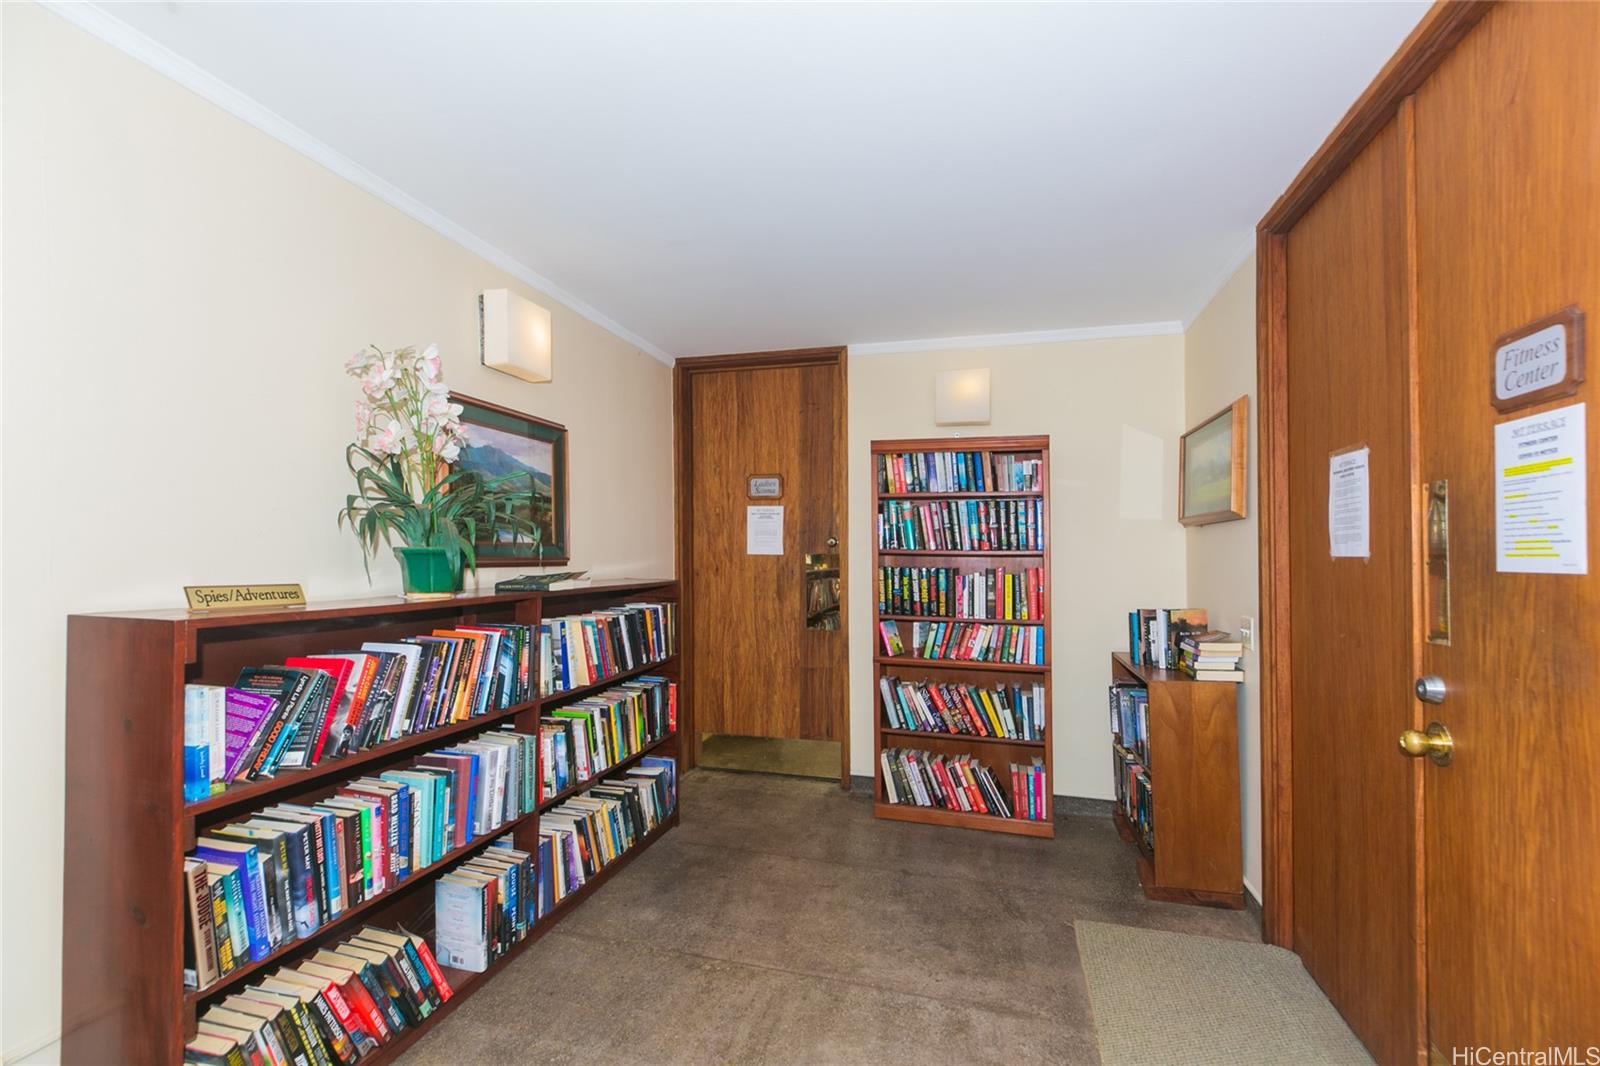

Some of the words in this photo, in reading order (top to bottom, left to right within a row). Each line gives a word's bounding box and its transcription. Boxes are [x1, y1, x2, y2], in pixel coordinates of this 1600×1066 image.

[1503, 338, 1560, 372] Fitness
[1504, 362, 1559, 392] Center
[194, 588, 300, 606] Spies/Adventures
[294, 675, 309, 694] Lynda
[290, 692, 299, 703] La
[282, 702, 295, 720] Plante
[268, 720, 284, 743] GOOD
[254, 742, 272, 772] FRIDAY
[390, 794, 398, 814] BRAD
[390, 814, 399, 846] MELTZER
[279, 841, 288, 864] PETER
[301, 831, 311, 856] PETER
[194, 870, 209, 893] THE
[196, 894, 212, 930] JUDGE
[312, 994, 329, 1015] JAMES
[322, 1012, 345, 1043] PATTERSON
